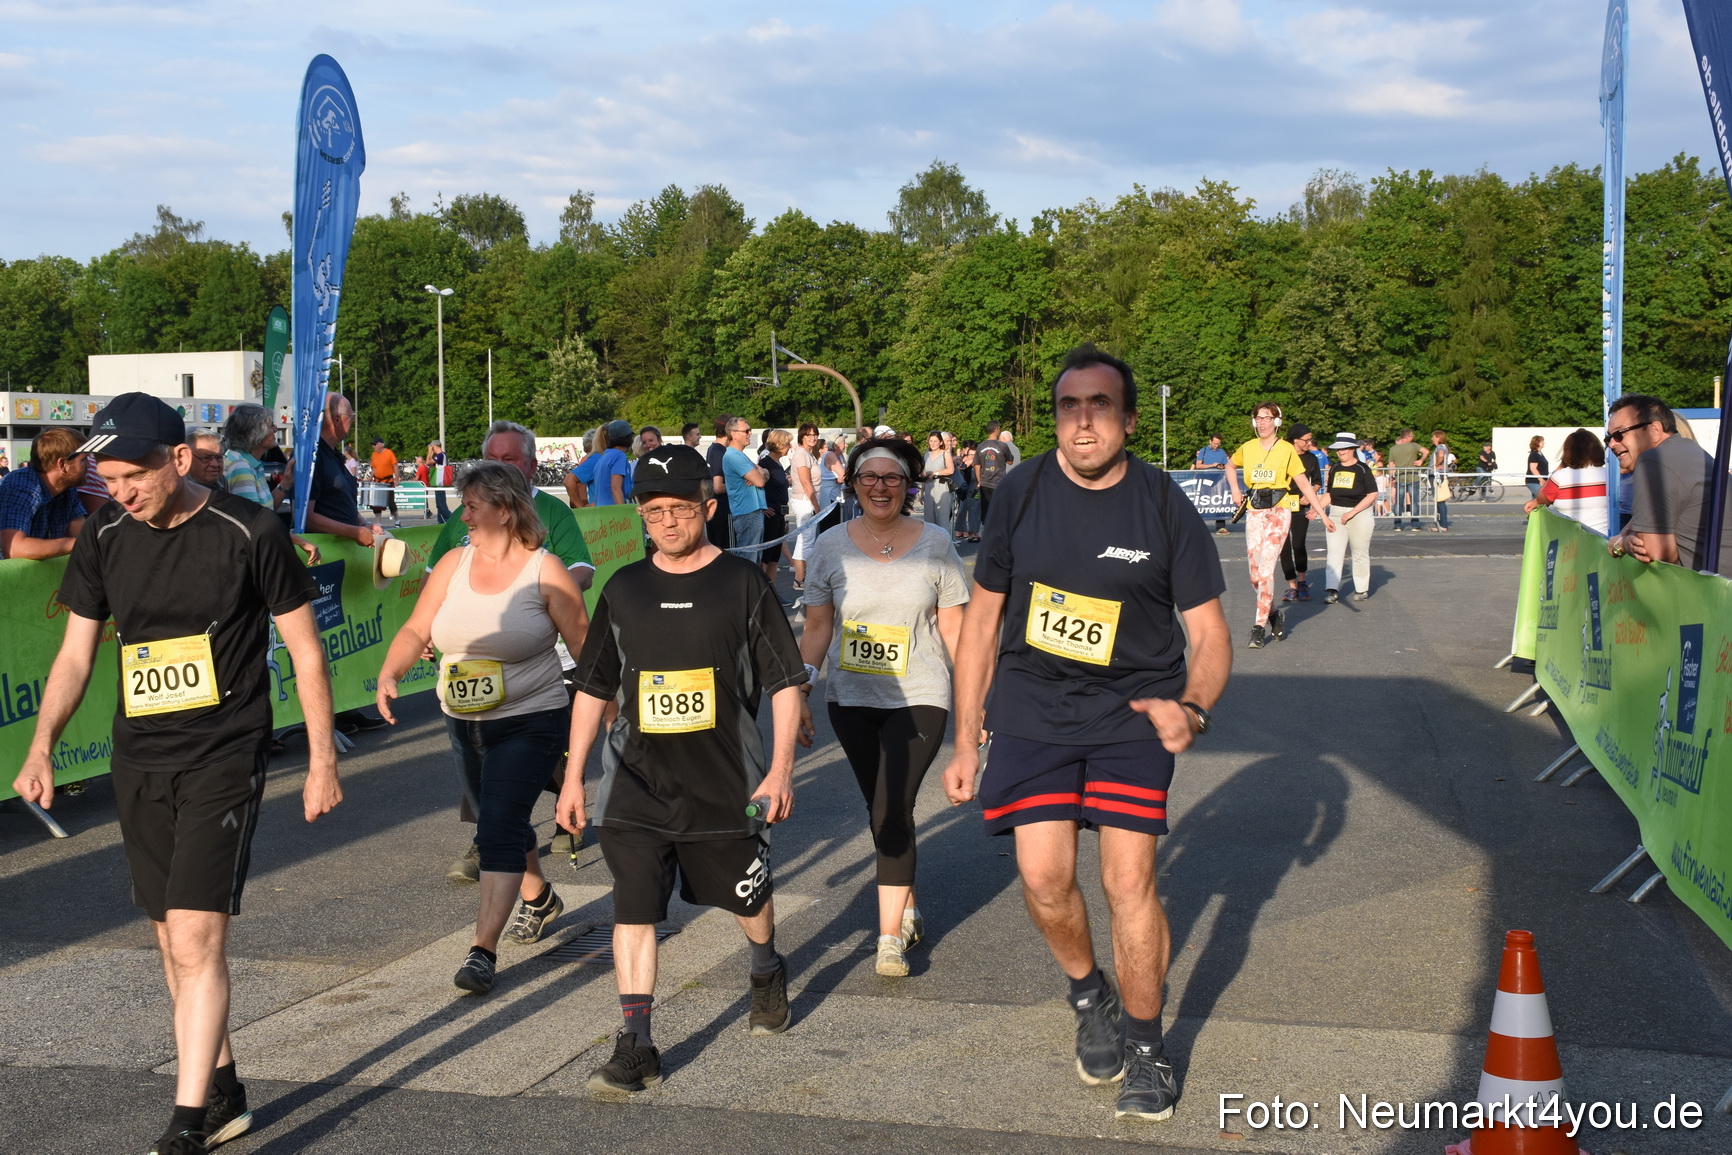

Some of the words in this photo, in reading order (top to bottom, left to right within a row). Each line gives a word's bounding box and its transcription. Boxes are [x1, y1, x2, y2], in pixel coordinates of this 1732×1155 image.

[1254, 470, 1273, 478] 2003
[1185, 491, 1234, 506] Fisch
[608, 517, 632, 537] Firmen
[1040, 610, 1103, 645] 1426
[849, 640, 899, 661] 1995
[1067, 641, 1092, 651] Thomas
[132, 662, 200, 695] 2000
[1683, 660, 1699, 677] Fischer
[148, 693, 163, 701] Wolf
[165, 691, 185, 699] Josef
[448, 676, 494, 699] 1973
[647, 691, 706, 716] 1988
